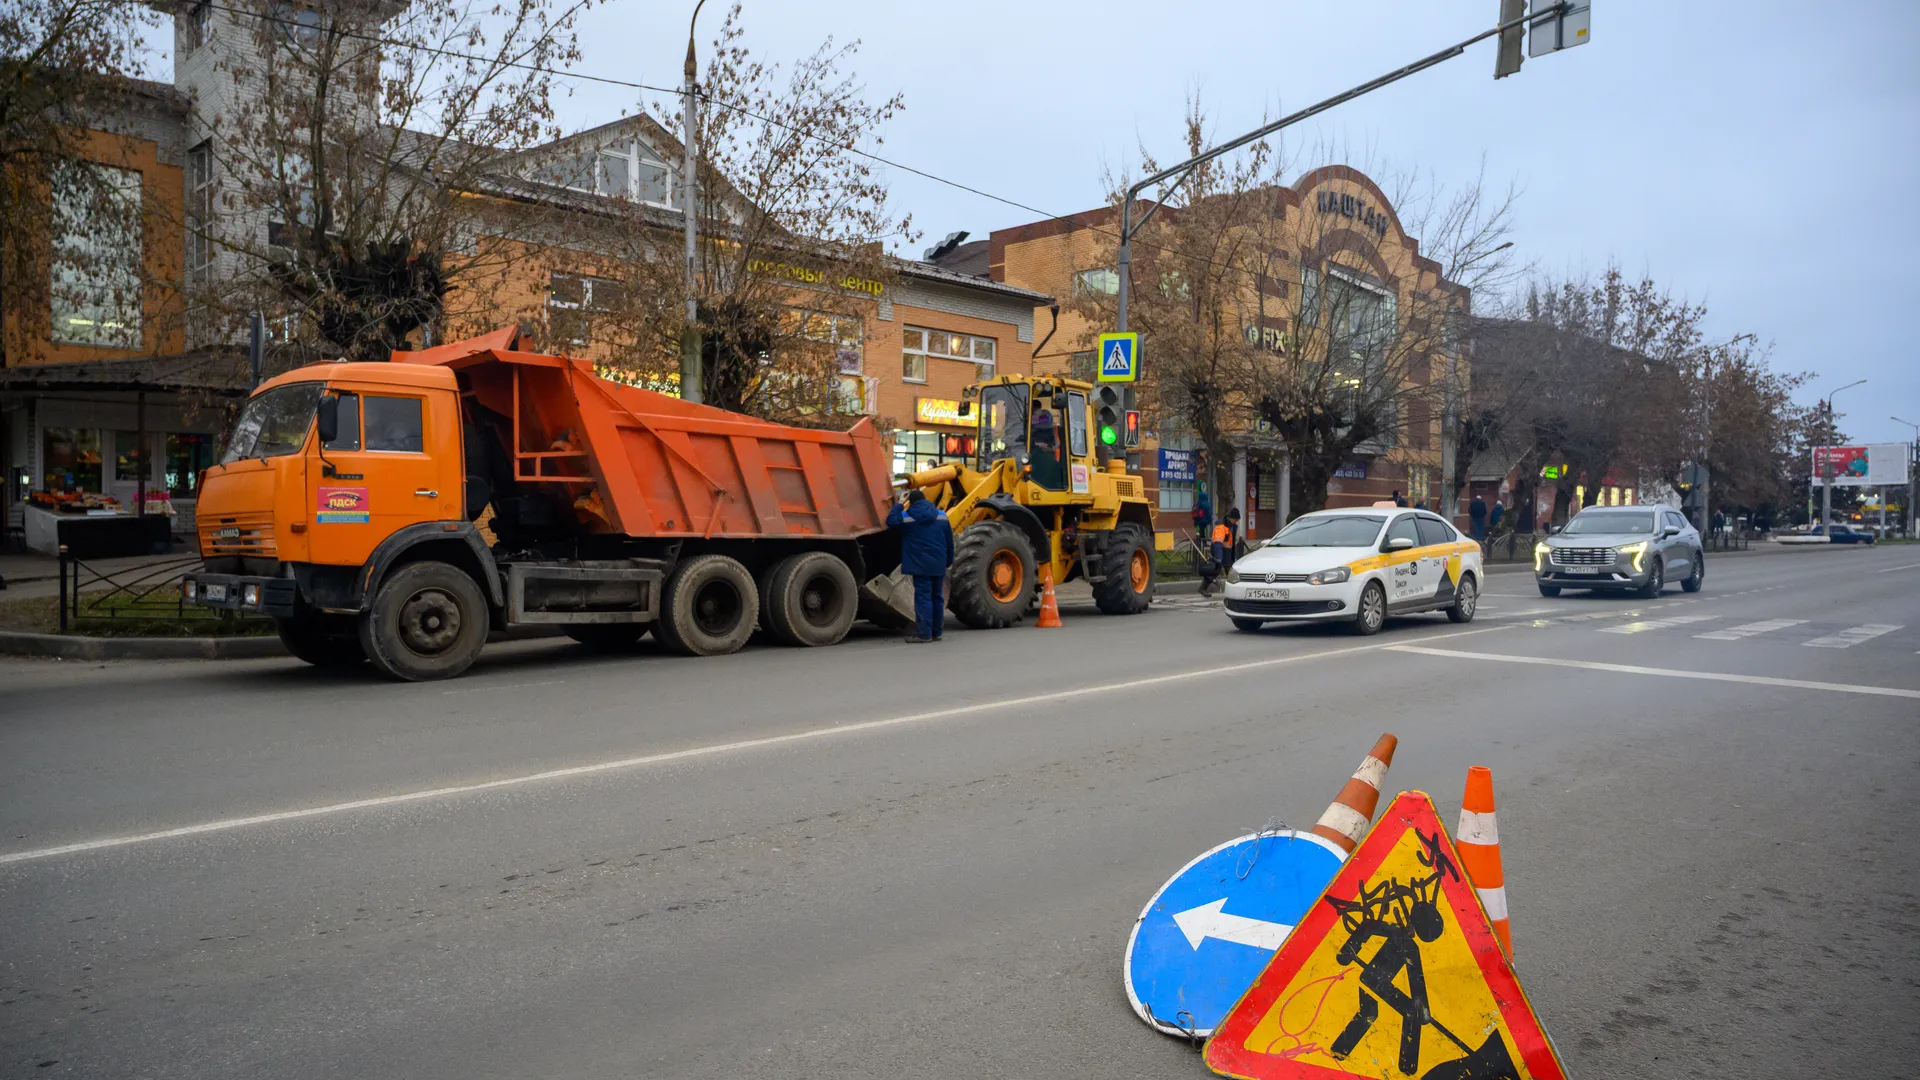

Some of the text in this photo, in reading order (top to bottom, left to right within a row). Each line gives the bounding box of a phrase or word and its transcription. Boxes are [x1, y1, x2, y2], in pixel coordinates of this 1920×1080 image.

[1317, 191, 1388, 237] КАШТАН
[329, 498, 357, 508] ПДСК
[1395, 567, 1410, 577] Яндекс
[1395, 580, 1407, 588] Такси
